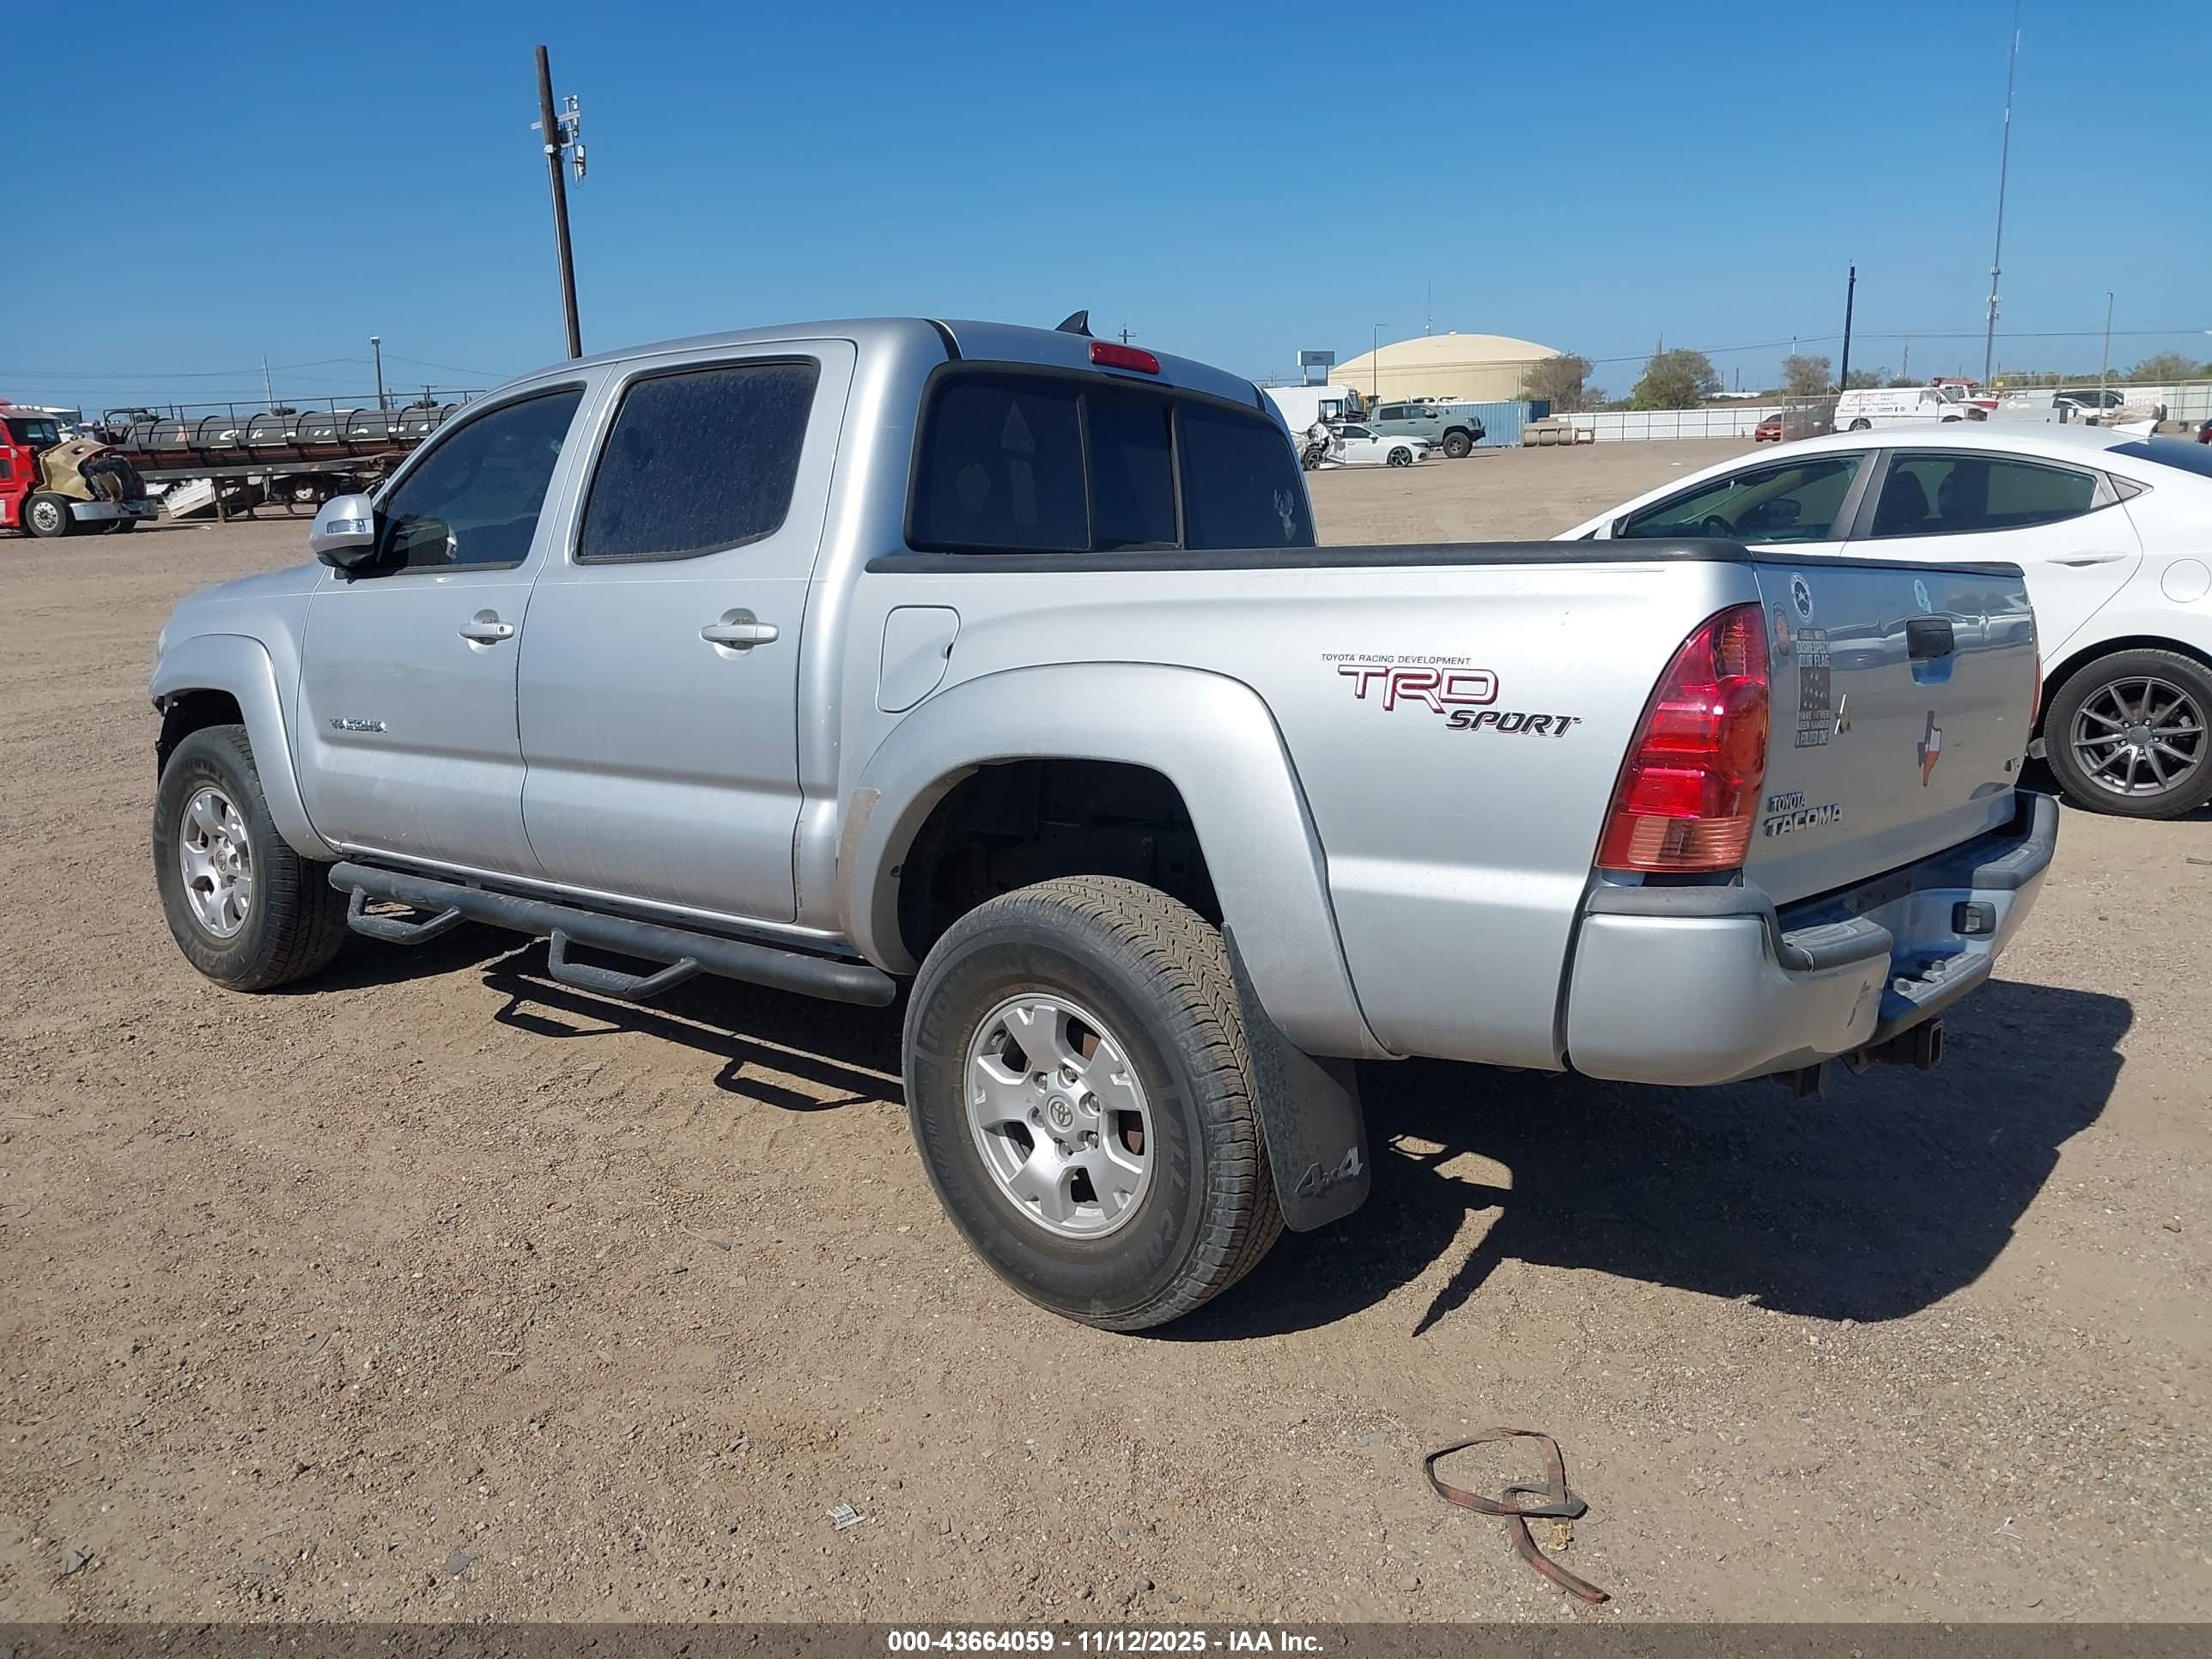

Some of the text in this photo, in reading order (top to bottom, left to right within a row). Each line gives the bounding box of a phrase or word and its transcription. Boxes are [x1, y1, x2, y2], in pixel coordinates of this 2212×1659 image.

[1321, 653, 1471, 665] TOYOTA RACING DEVELOPMENT
[1814, 653, 1830, 667] FLAG
[1337, 664, 1499, 714] TRD
[1444, 709, 1583, 738] SPORT
[1769, 791, 1806, 812] TOYOTA
[1763, 804, 1842, 837] TACOMA
